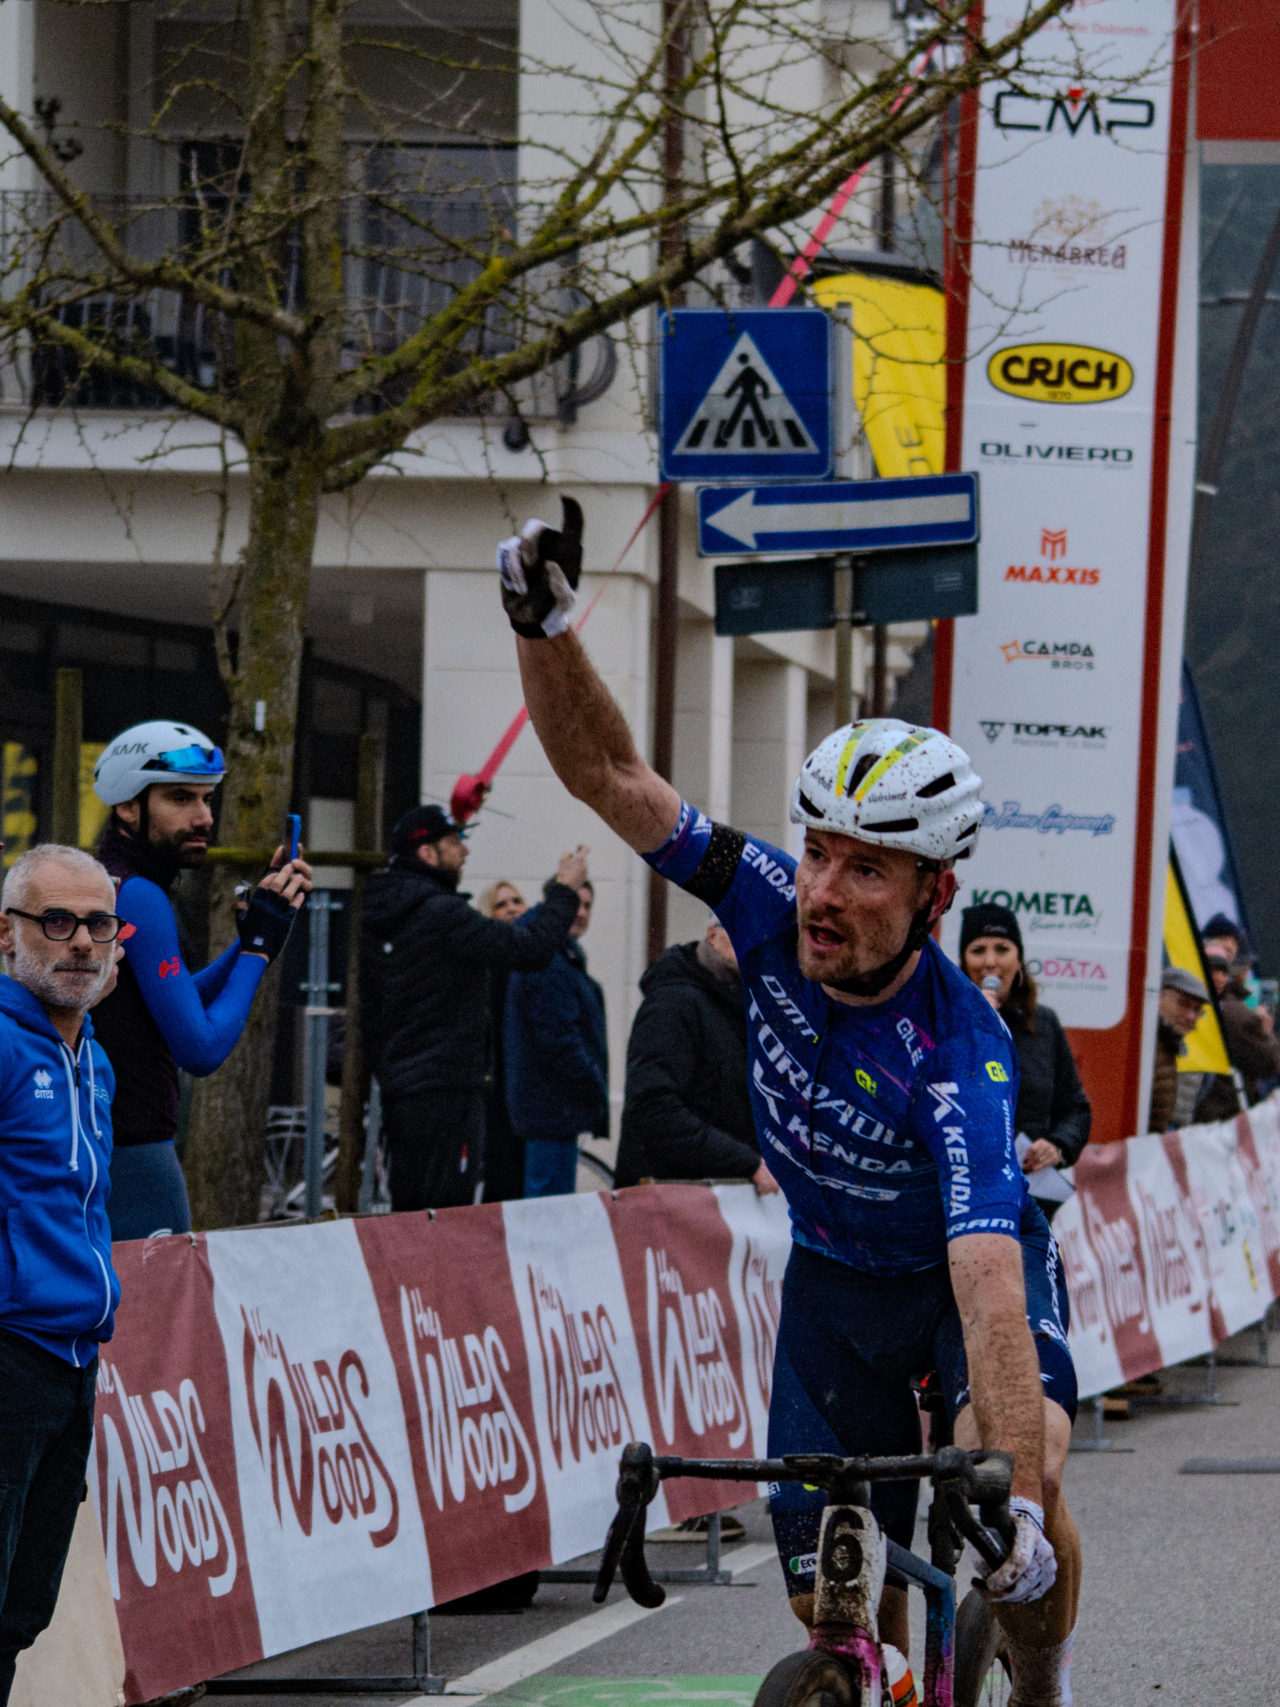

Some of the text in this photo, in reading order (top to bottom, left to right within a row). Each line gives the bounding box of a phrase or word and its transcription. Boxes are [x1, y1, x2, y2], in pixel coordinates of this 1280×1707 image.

[994, 88, 1155, 136] CMP
[1002, 356, 1119, 391] CRICH
[981, 442, 1134, 463] OLIVIERO
[1004, 566, 1100, 586] MAXXIS
[1023, 641, 1095, 658] CAMPA
[1052, 660, 1095, 671] BROS
[1010, 723, 1106, 739] TOPEAK
[741, 842, 798, 903] ENDA
[971, 889, 1094, 917] KOMETA
[1027, 957, 1108, 980] ODATA
[1003, 1099, 1015, 1160] Formula
[786, 1114, 912, 1174] KENDA
[941, 1126, 972, 1218] KENDA
[946, 1217, 1016, 1238] RAM
[821, 1507, 865, 1581] 6
